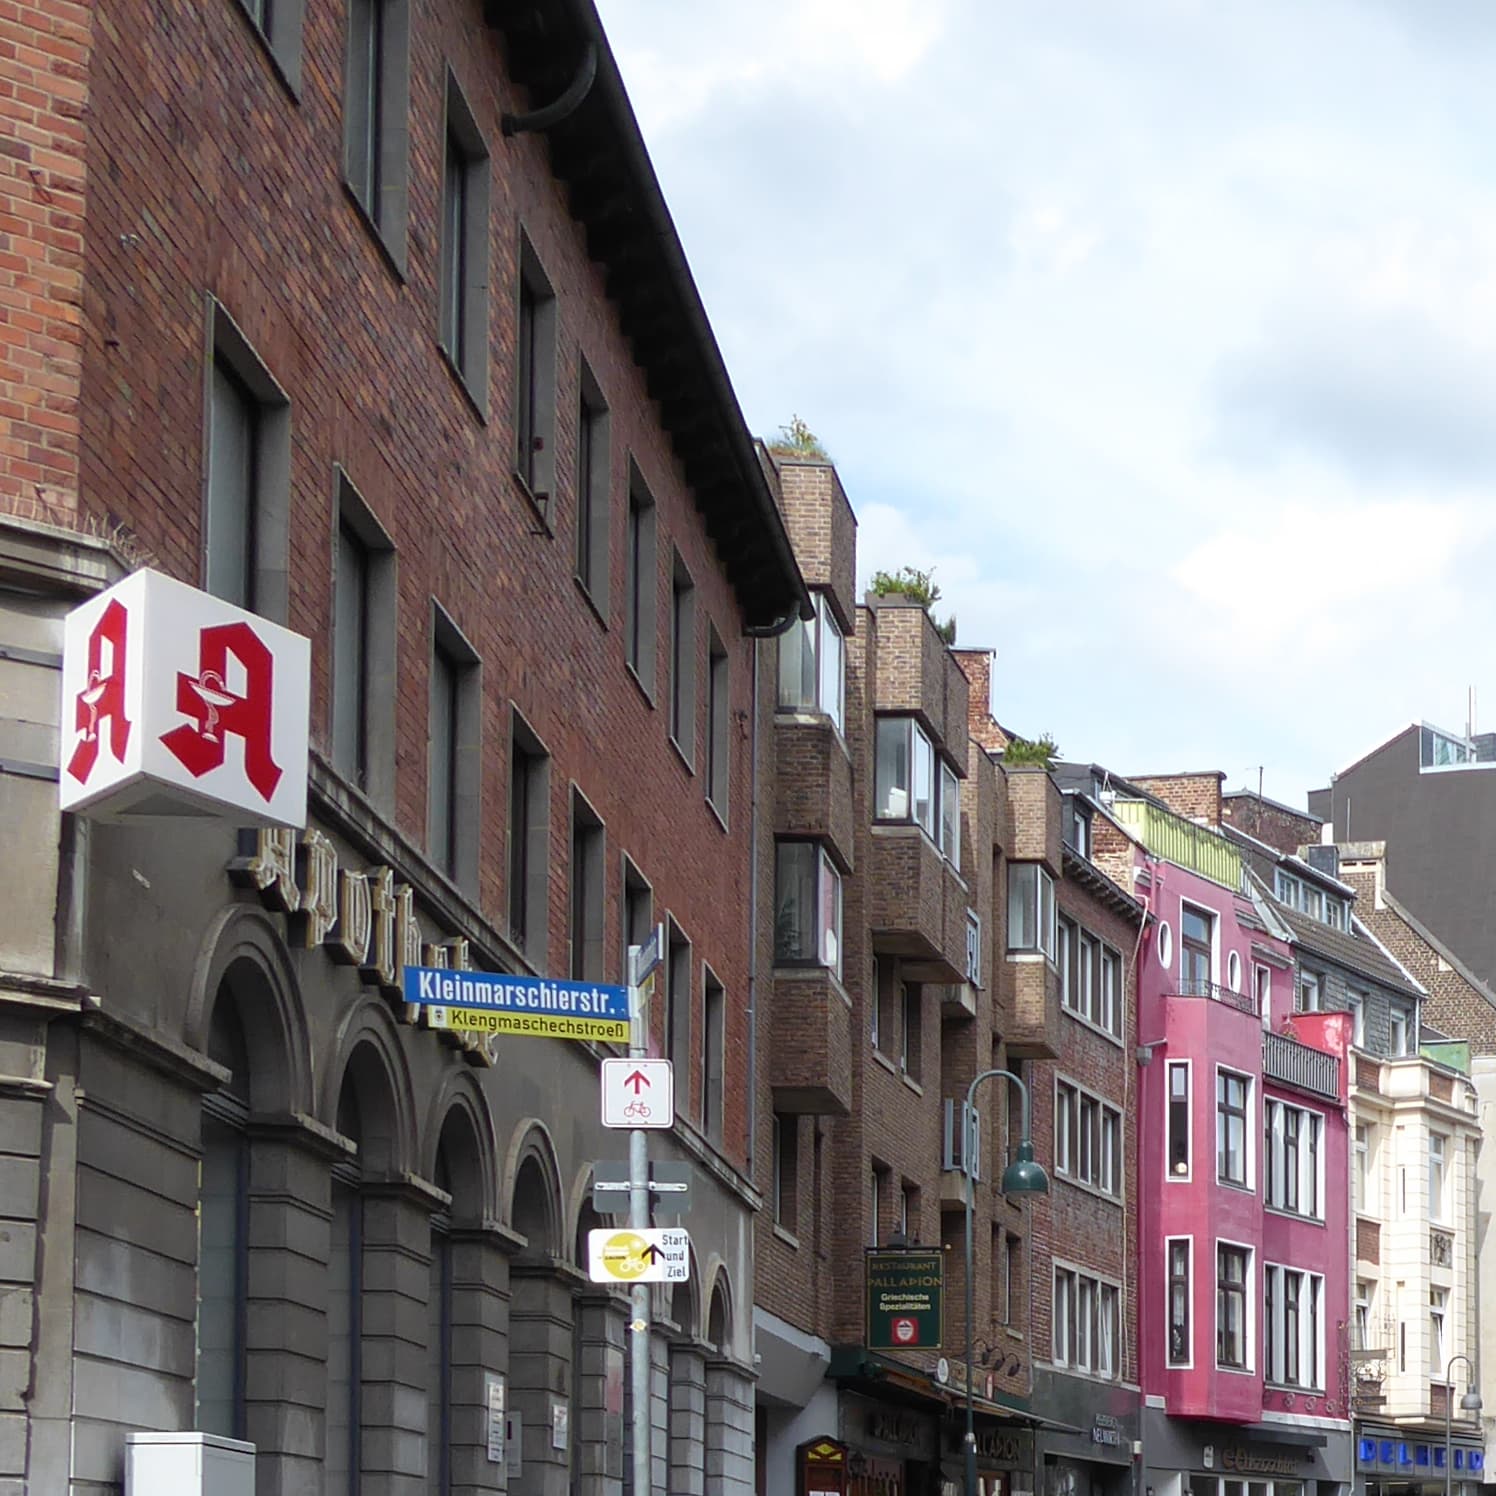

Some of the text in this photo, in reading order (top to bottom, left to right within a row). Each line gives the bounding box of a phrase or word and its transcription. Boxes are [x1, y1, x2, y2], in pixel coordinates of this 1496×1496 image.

[66, 597, 133, 786] A
[157, 621, 284, 803] A
[418, 971, 616, 1015] Kleinmarschierstr.
[451, 1009, 625, 1038] Klengmaschechstroeß
[662, 1234, 689, 1246] Start
[666, 1250, 685, 1261] und
[667, 1266, 686, 1278] Ziel
